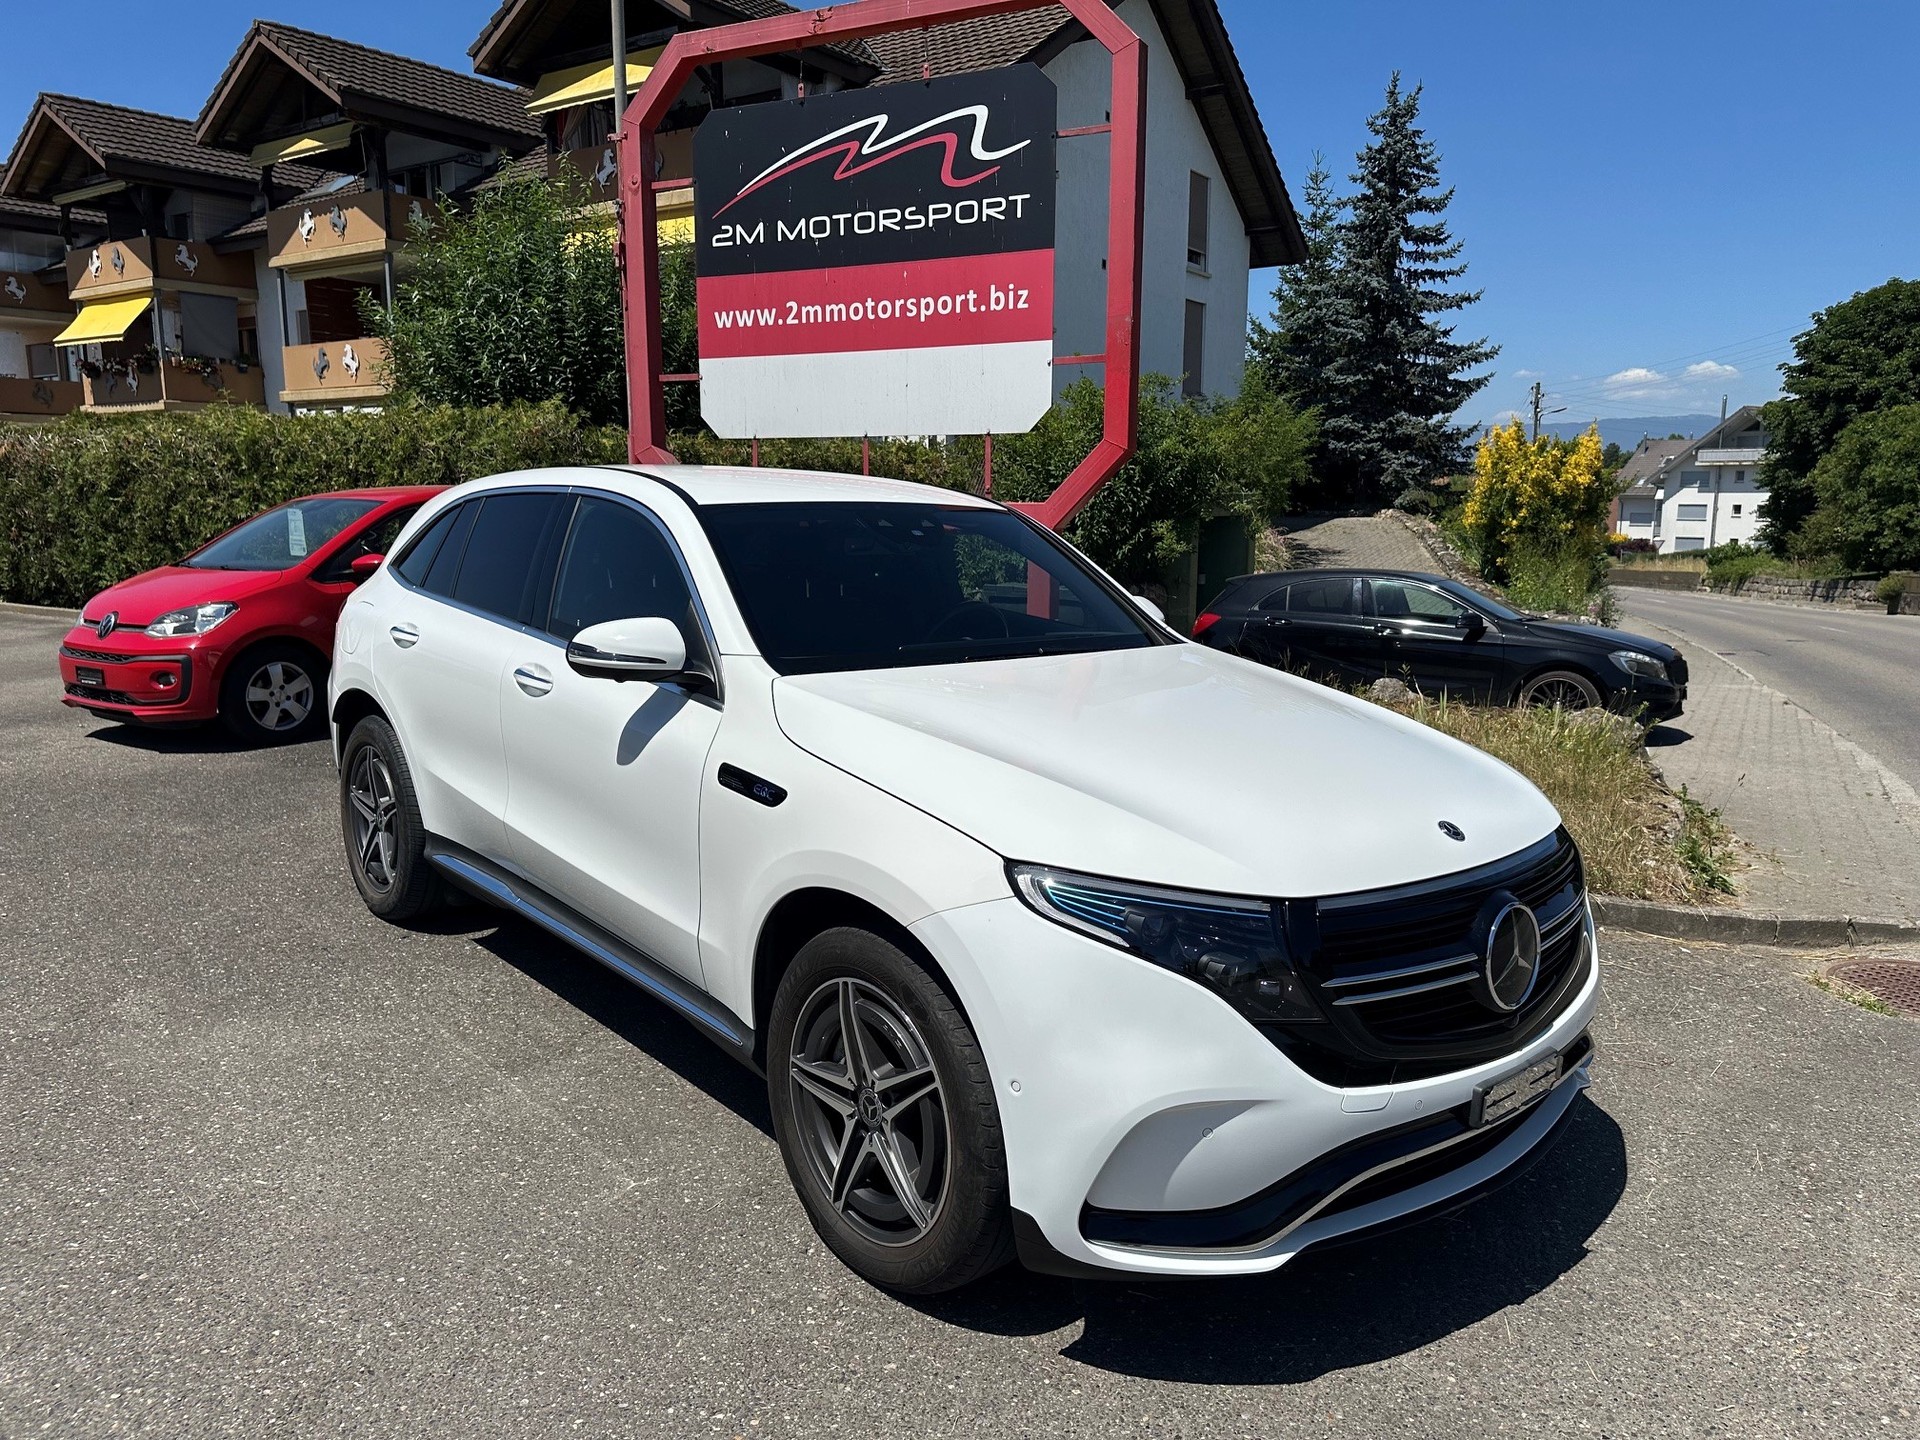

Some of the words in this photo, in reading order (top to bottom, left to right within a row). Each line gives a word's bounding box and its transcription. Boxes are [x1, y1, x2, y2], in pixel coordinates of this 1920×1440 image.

[712, 222, 764, 247] 2M
[777, 193, 1031, 242] MOTORSPORT
[714, 283, 1030, 329] www.2mmotorsport.biz
[753, 783, 775, 801] EQC
